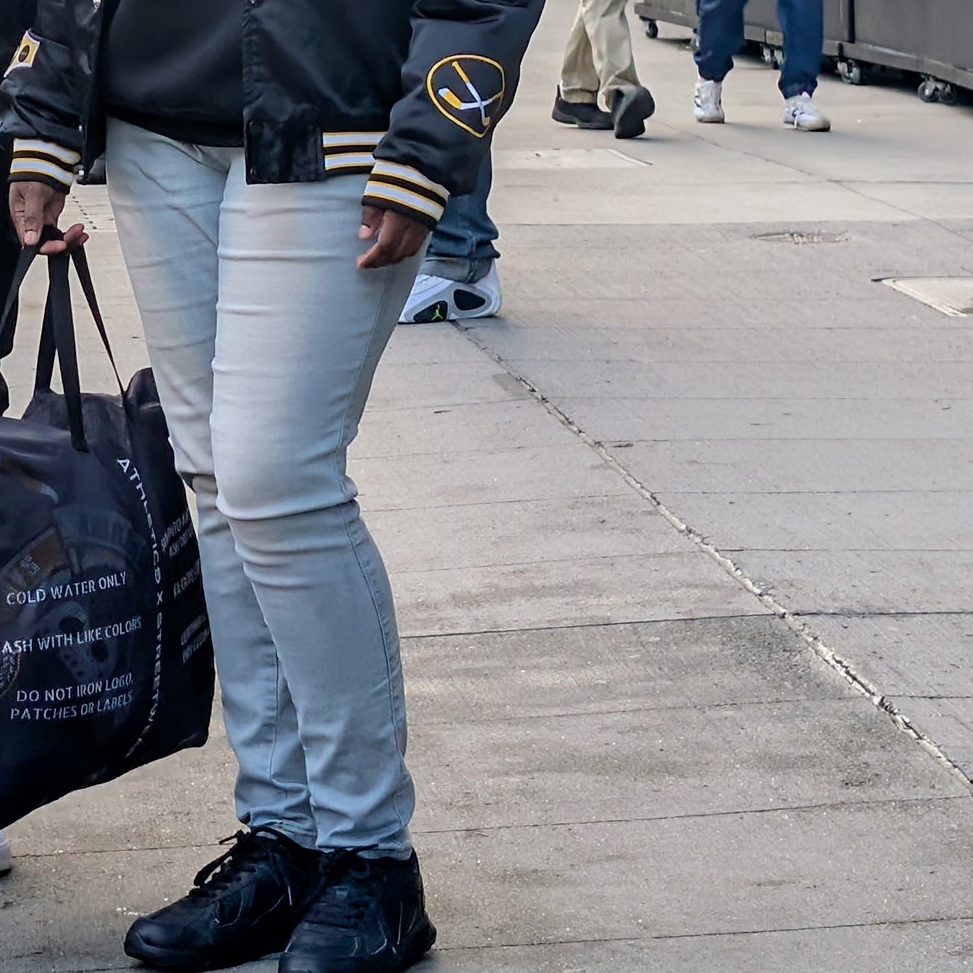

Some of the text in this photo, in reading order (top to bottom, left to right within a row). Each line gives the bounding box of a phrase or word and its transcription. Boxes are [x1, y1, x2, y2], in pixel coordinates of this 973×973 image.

[6, 571, 127, 605] COLD WATER ONLY
[37, 633, 73, 651] WITH
[77, 626, 102, 644] LIKE
[105, 616, 142, 638] COLORS
[10, 690, 134, 720] PATCHES OR LABELS
[16, 690, 40, 702] DO
[44, 686, 73, 701] NOT
[77, 680, 103, 698] IRON
